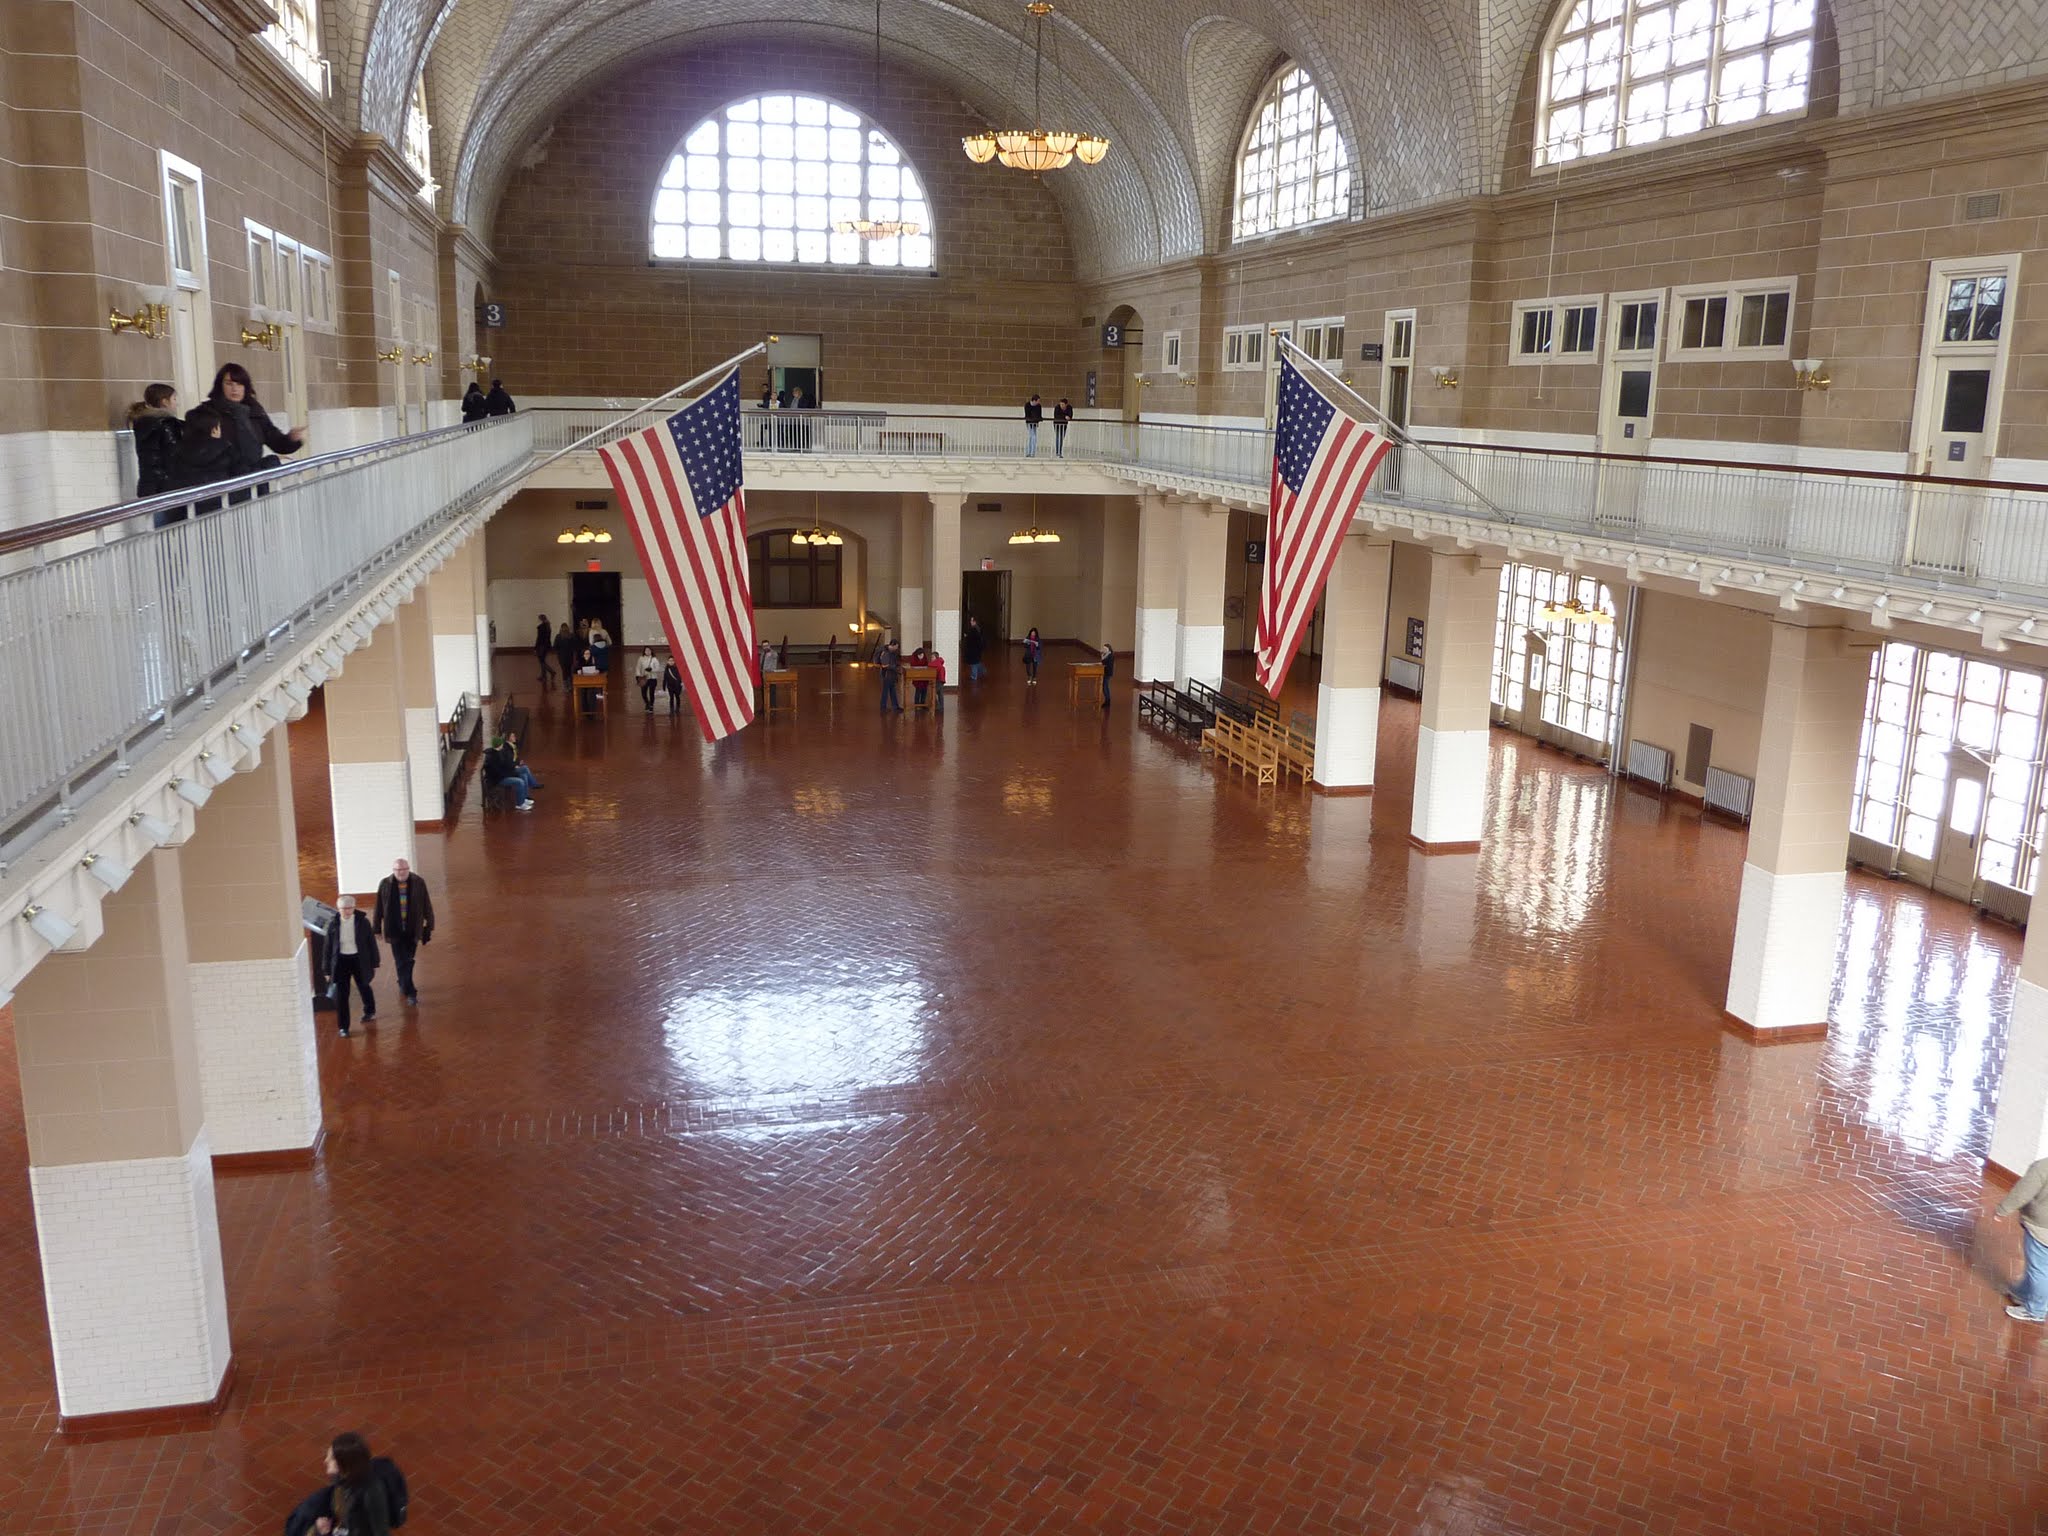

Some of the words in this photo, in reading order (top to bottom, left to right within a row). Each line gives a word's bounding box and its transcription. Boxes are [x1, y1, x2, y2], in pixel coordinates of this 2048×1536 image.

[488, 304, 500, 320] 3
[1107, 326, 1118, 341] 3
[1249, 544, 1258, 556] 2
